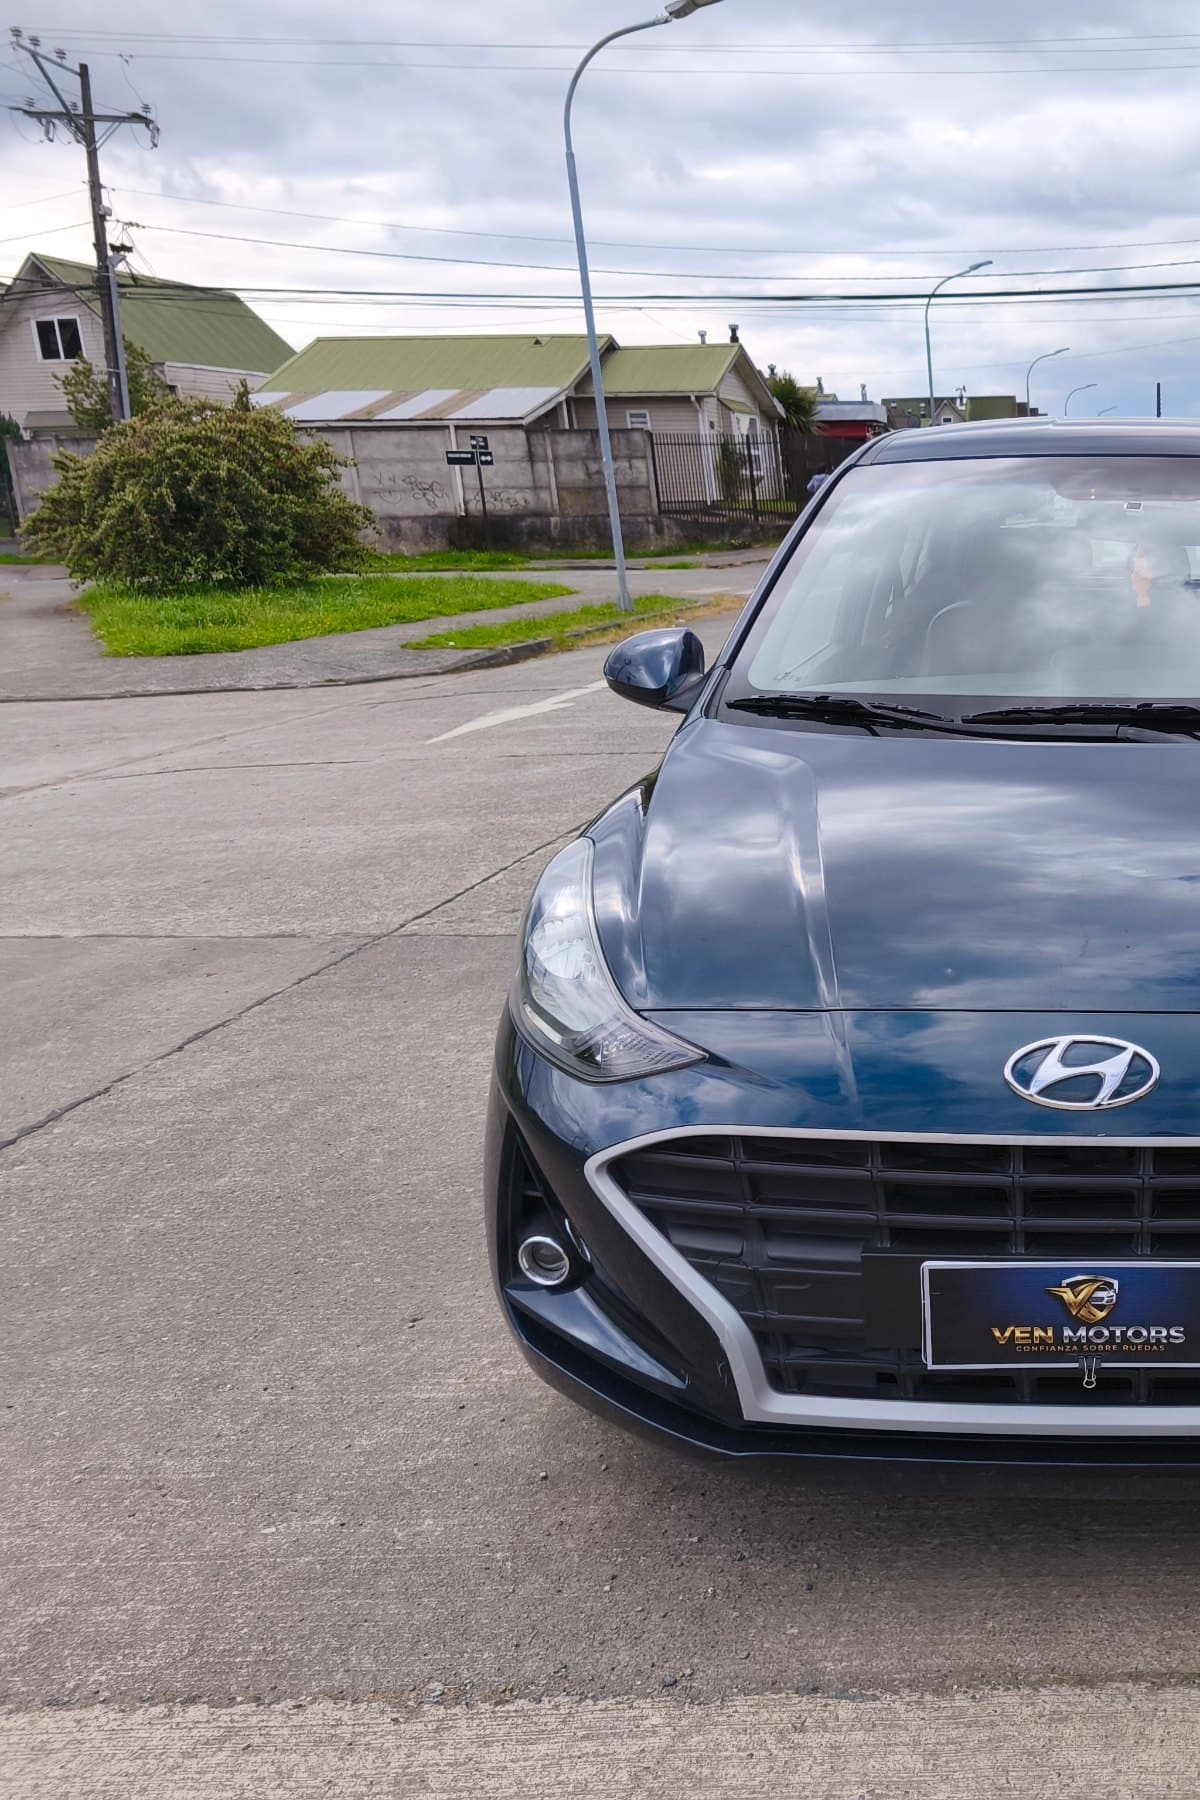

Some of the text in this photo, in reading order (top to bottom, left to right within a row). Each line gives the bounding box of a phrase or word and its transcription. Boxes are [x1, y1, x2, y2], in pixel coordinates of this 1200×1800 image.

[991, 1326, 1186, 1344] VEN MOTORS
[1122, 1344, 1166, 1352] RUEDAS
